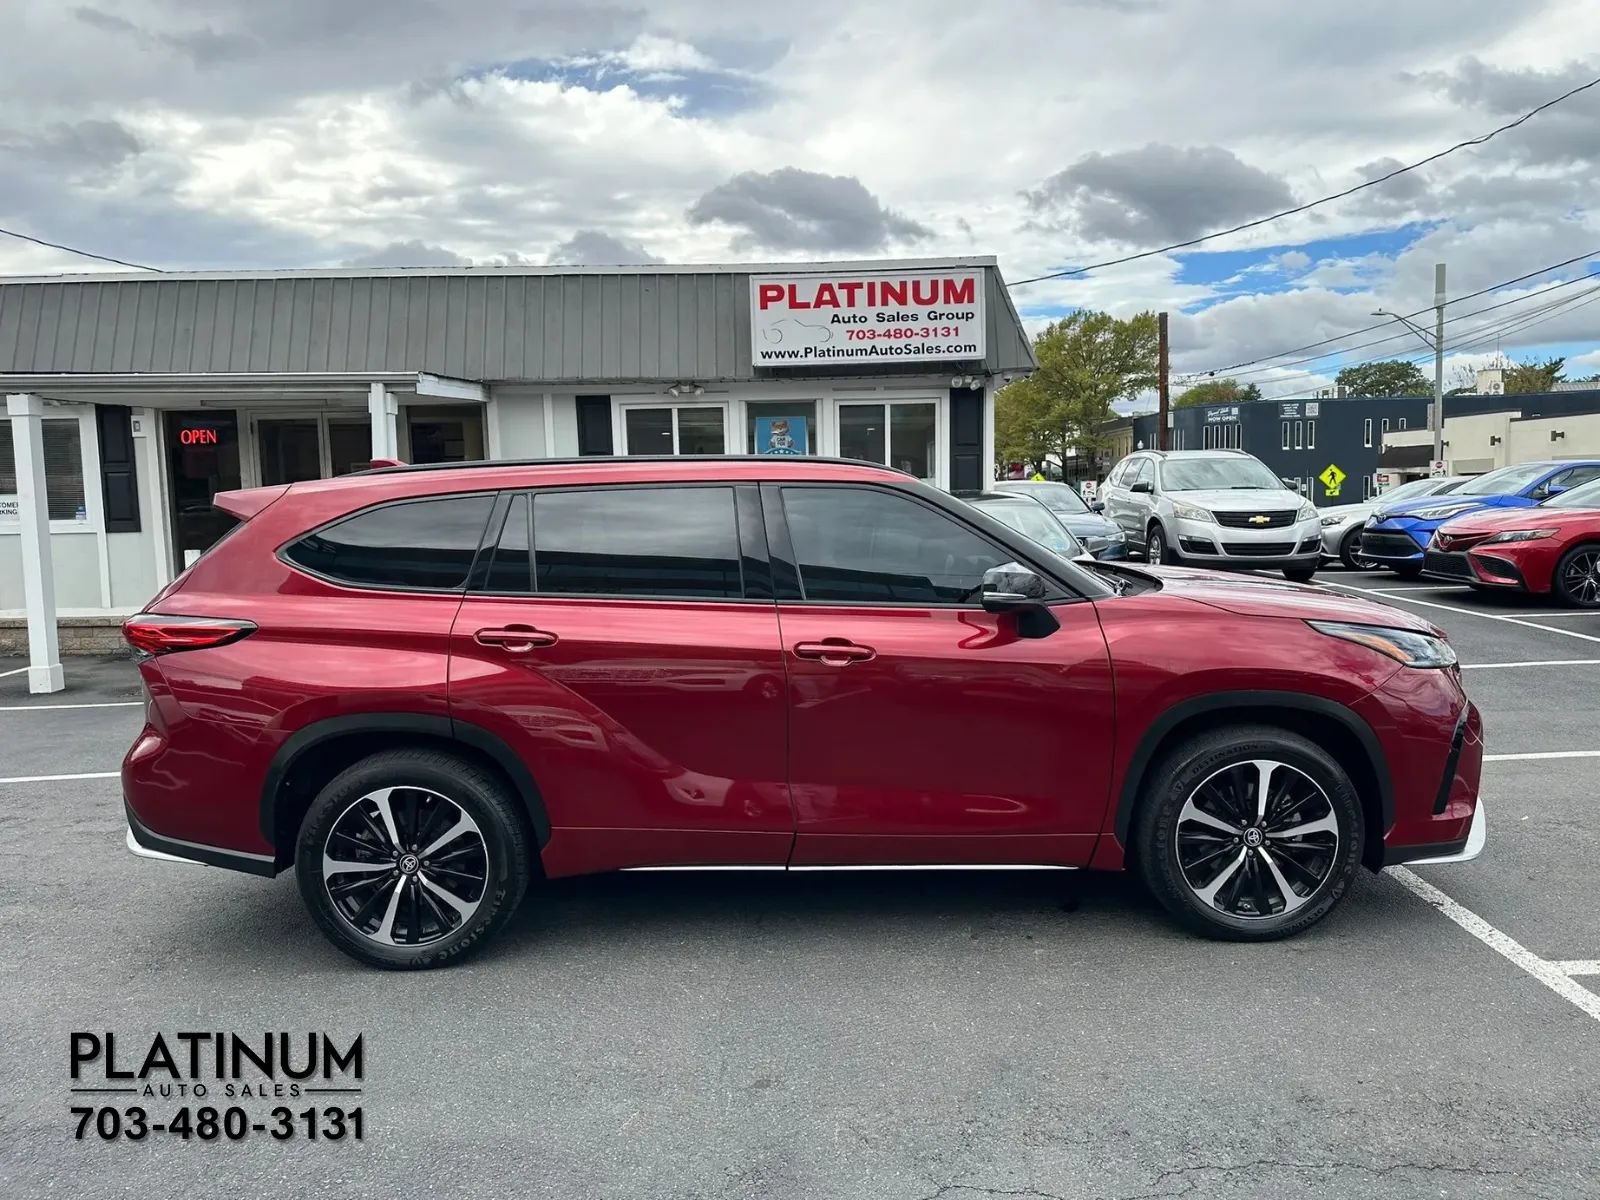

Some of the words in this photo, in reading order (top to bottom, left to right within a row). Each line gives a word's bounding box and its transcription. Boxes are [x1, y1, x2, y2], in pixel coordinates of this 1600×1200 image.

[759, 278, 975, 310] PLATINUM
[830, 313, 868, 325] Auto
[876, 311, 919, 323] Sales
[927, 310, 975, 323] Group
[846, 326, 960, 341] 703-480-3131
[760, 343, 977, 360] www.PlatinumAutoSales.com
[180, 429, 217, 445] OPEN
